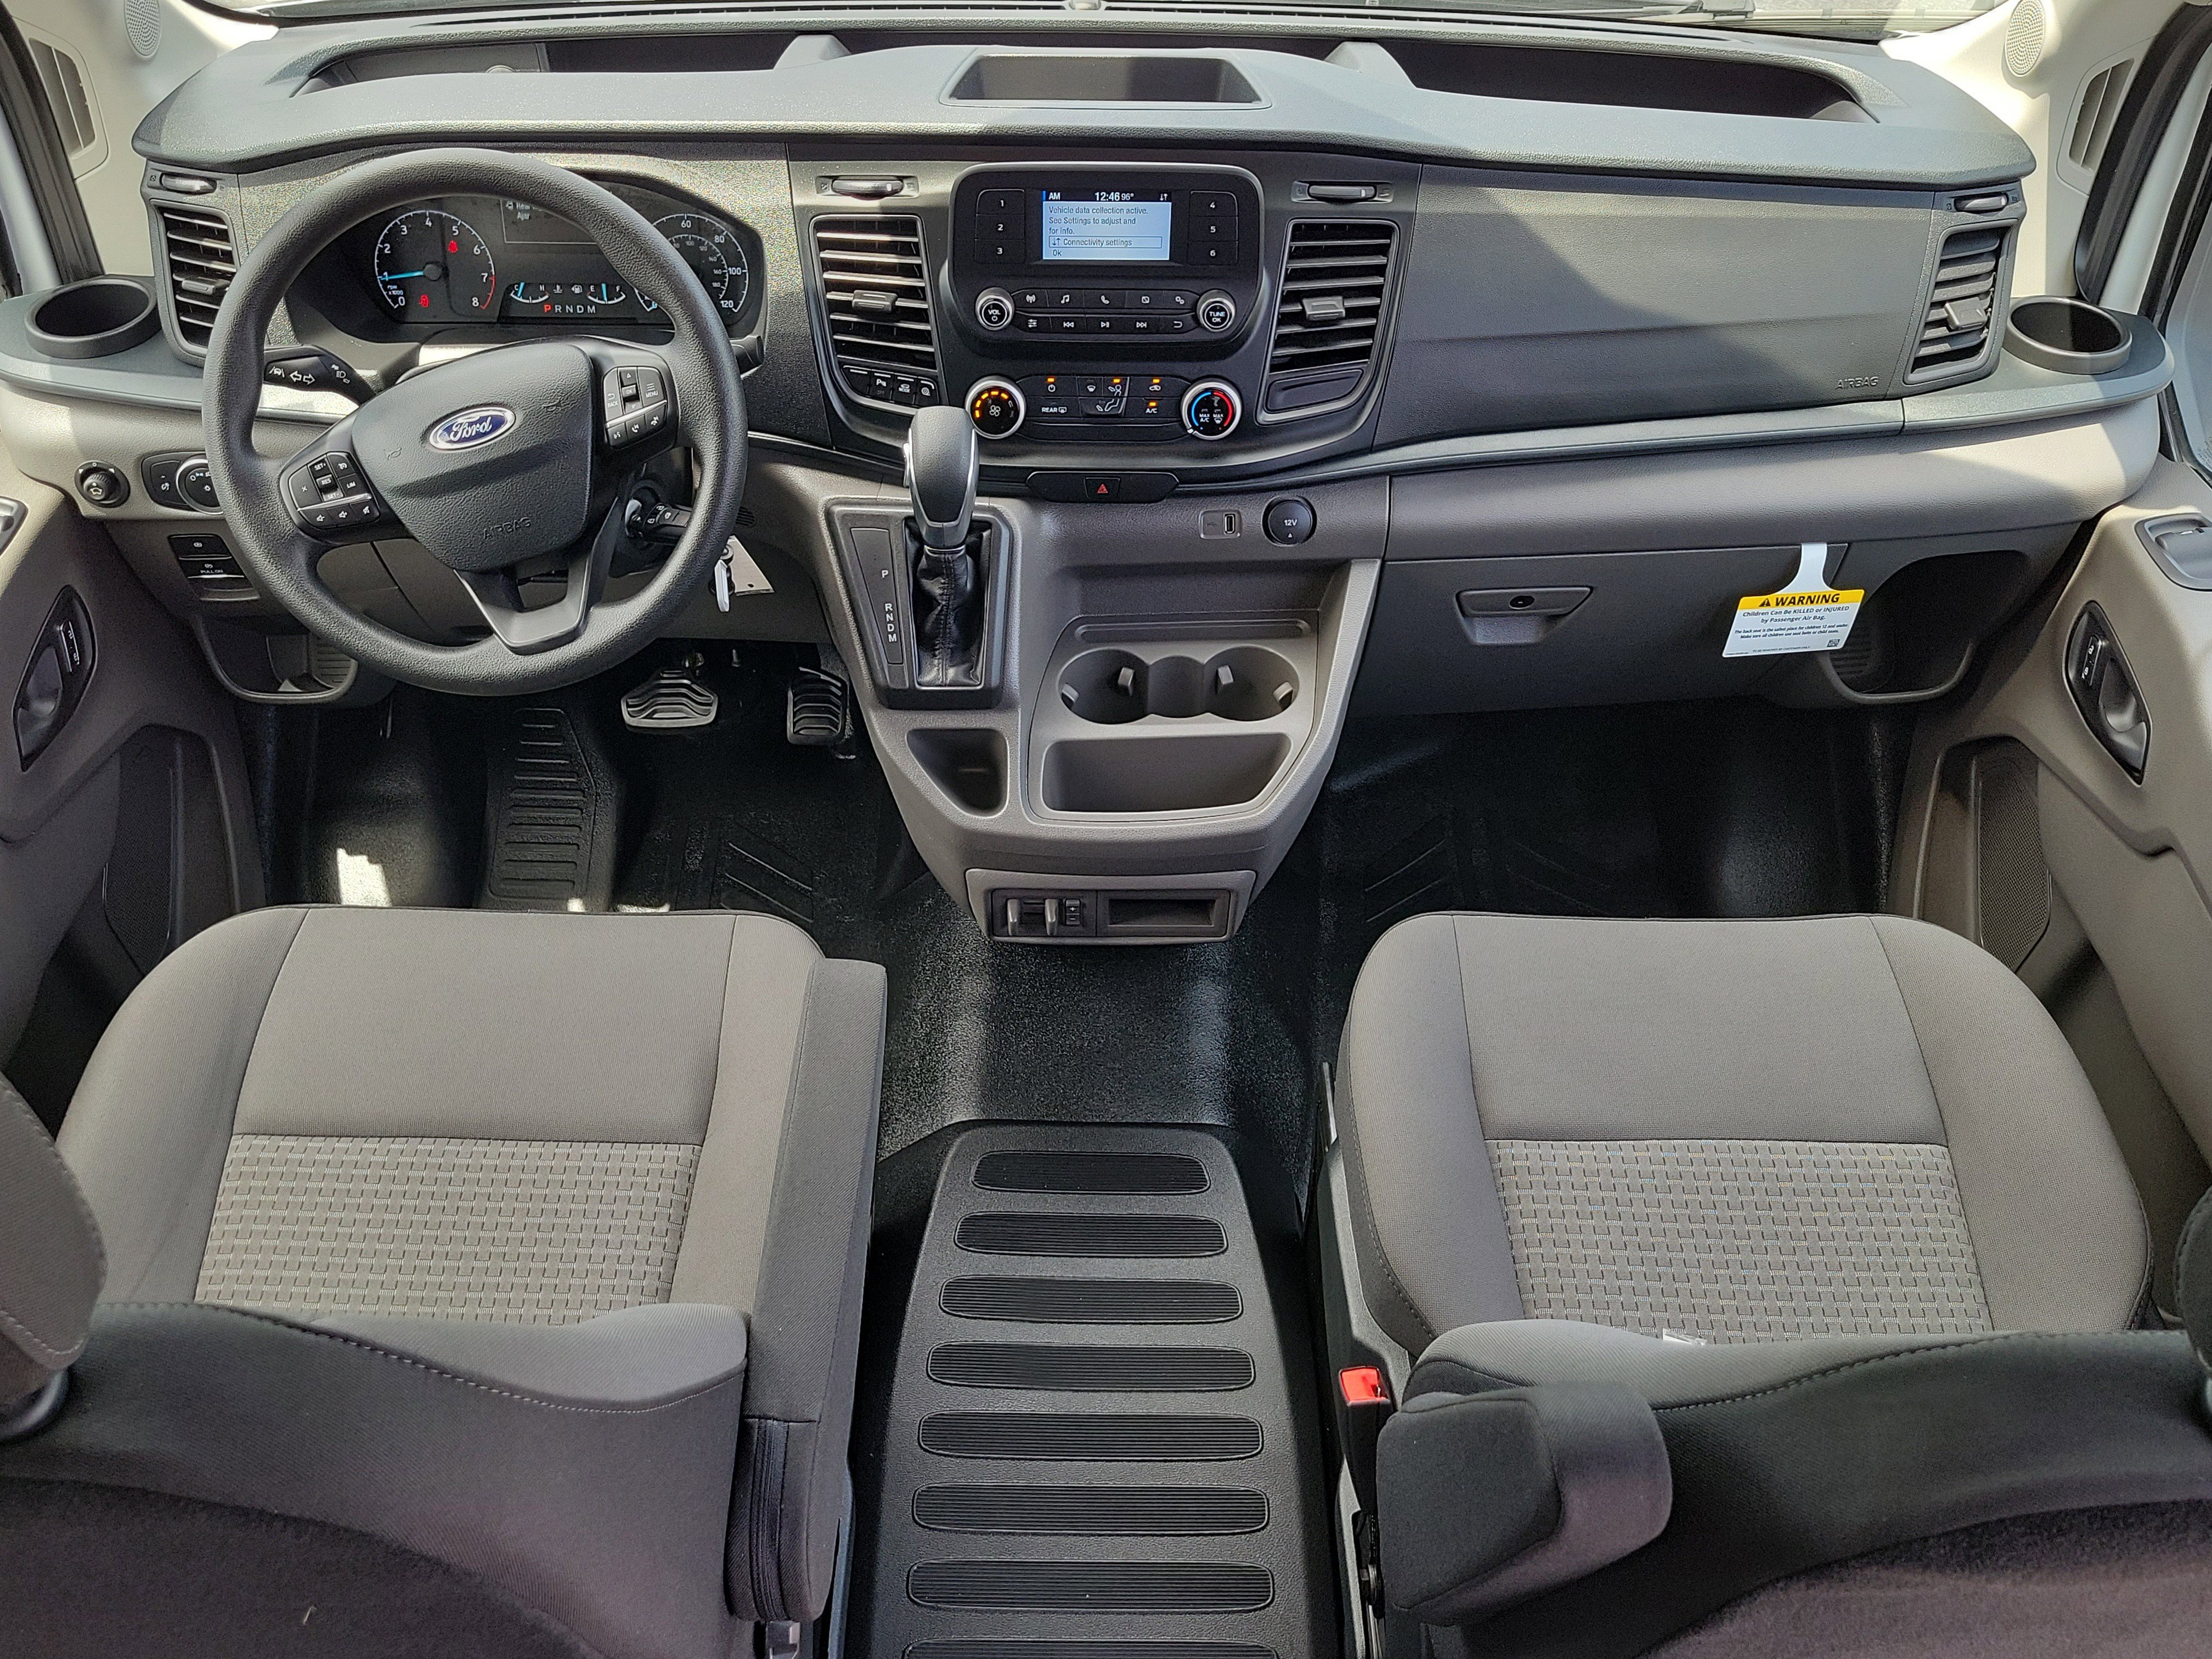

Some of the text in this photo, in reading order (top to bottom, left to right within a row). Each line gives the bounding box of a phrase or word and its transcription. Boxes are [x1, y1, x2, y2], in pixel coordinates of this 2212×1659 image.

[1095, 193, 1120, 201] 12:46
[425, 217, 432, 227] 4
[681, 220, 691, 228] 60
[1064, 217, 1091, 225] Settings
[400, 225, 408, 235] 3
[452, 226, 459, 235] 5
[1063, 239, 1104, 247] Connectivity
[384, 244, 391, 253] 2
[473, 245, 481, 255] 6
[481, 273, 488, 283] 7
[398, 296, 405, 306] 0
[472, 297, 479, 307] 8
[544, 304, 552, 313] P
[588, 305, 596, 313] M
[1836, 376, 1882, 390] AIRBAG
[450, 416, 492, 442] Ford
[483, 517, 531, 541] AIRBAG
[881, 569, 889, 578] P
[1775, 594, 1840, 607] WARNING
[884, 603, 893, 612] R
[886, 613, 894, 622] N
[887, 623, 895, 632] D
[888, 633, 897, 642] M
